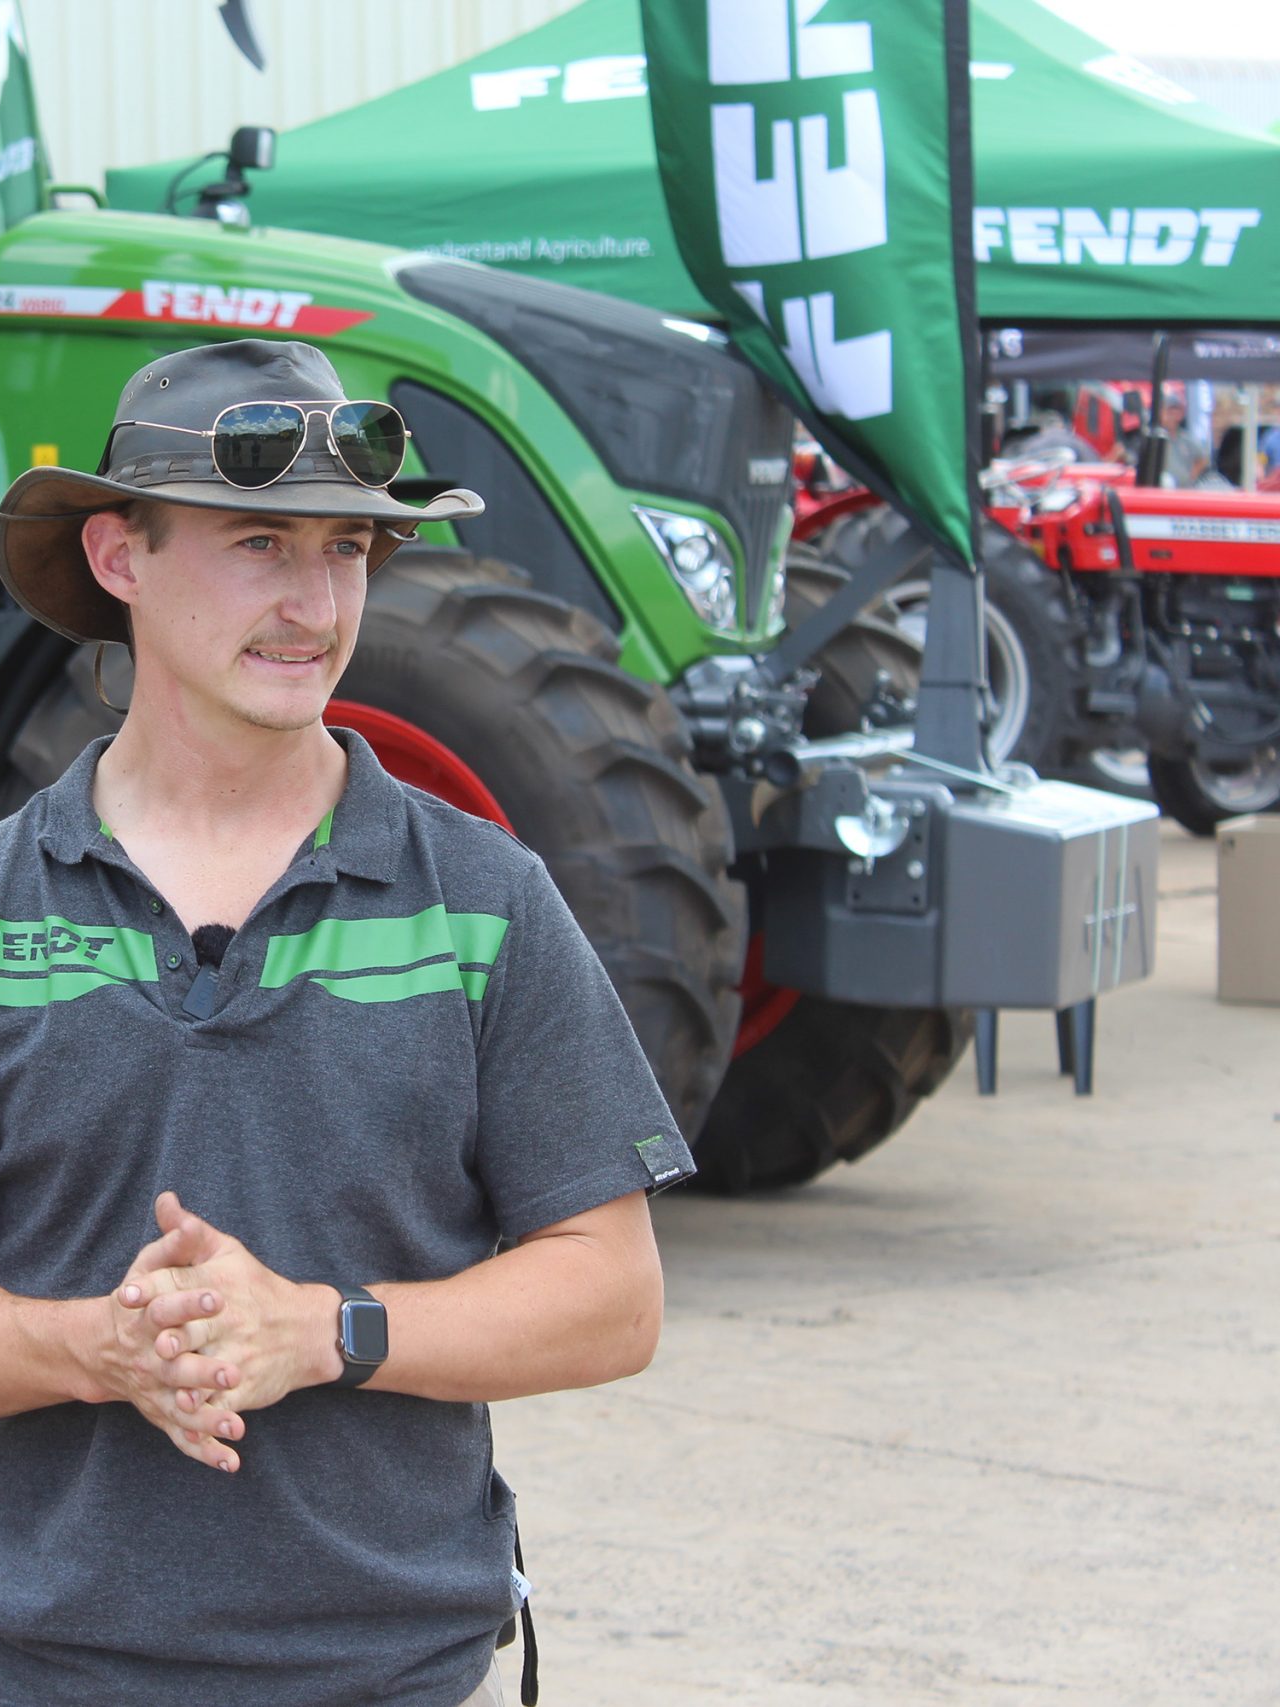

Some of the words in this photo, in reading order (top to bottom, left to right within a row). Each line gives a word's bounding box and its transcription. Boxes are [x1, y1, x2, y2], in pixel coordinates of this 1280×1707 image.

[537, 237, 654, 264] Agriculture.
[972, 206, 1262, 266] FENDT
[141, 281, 313, 328] FENDT
